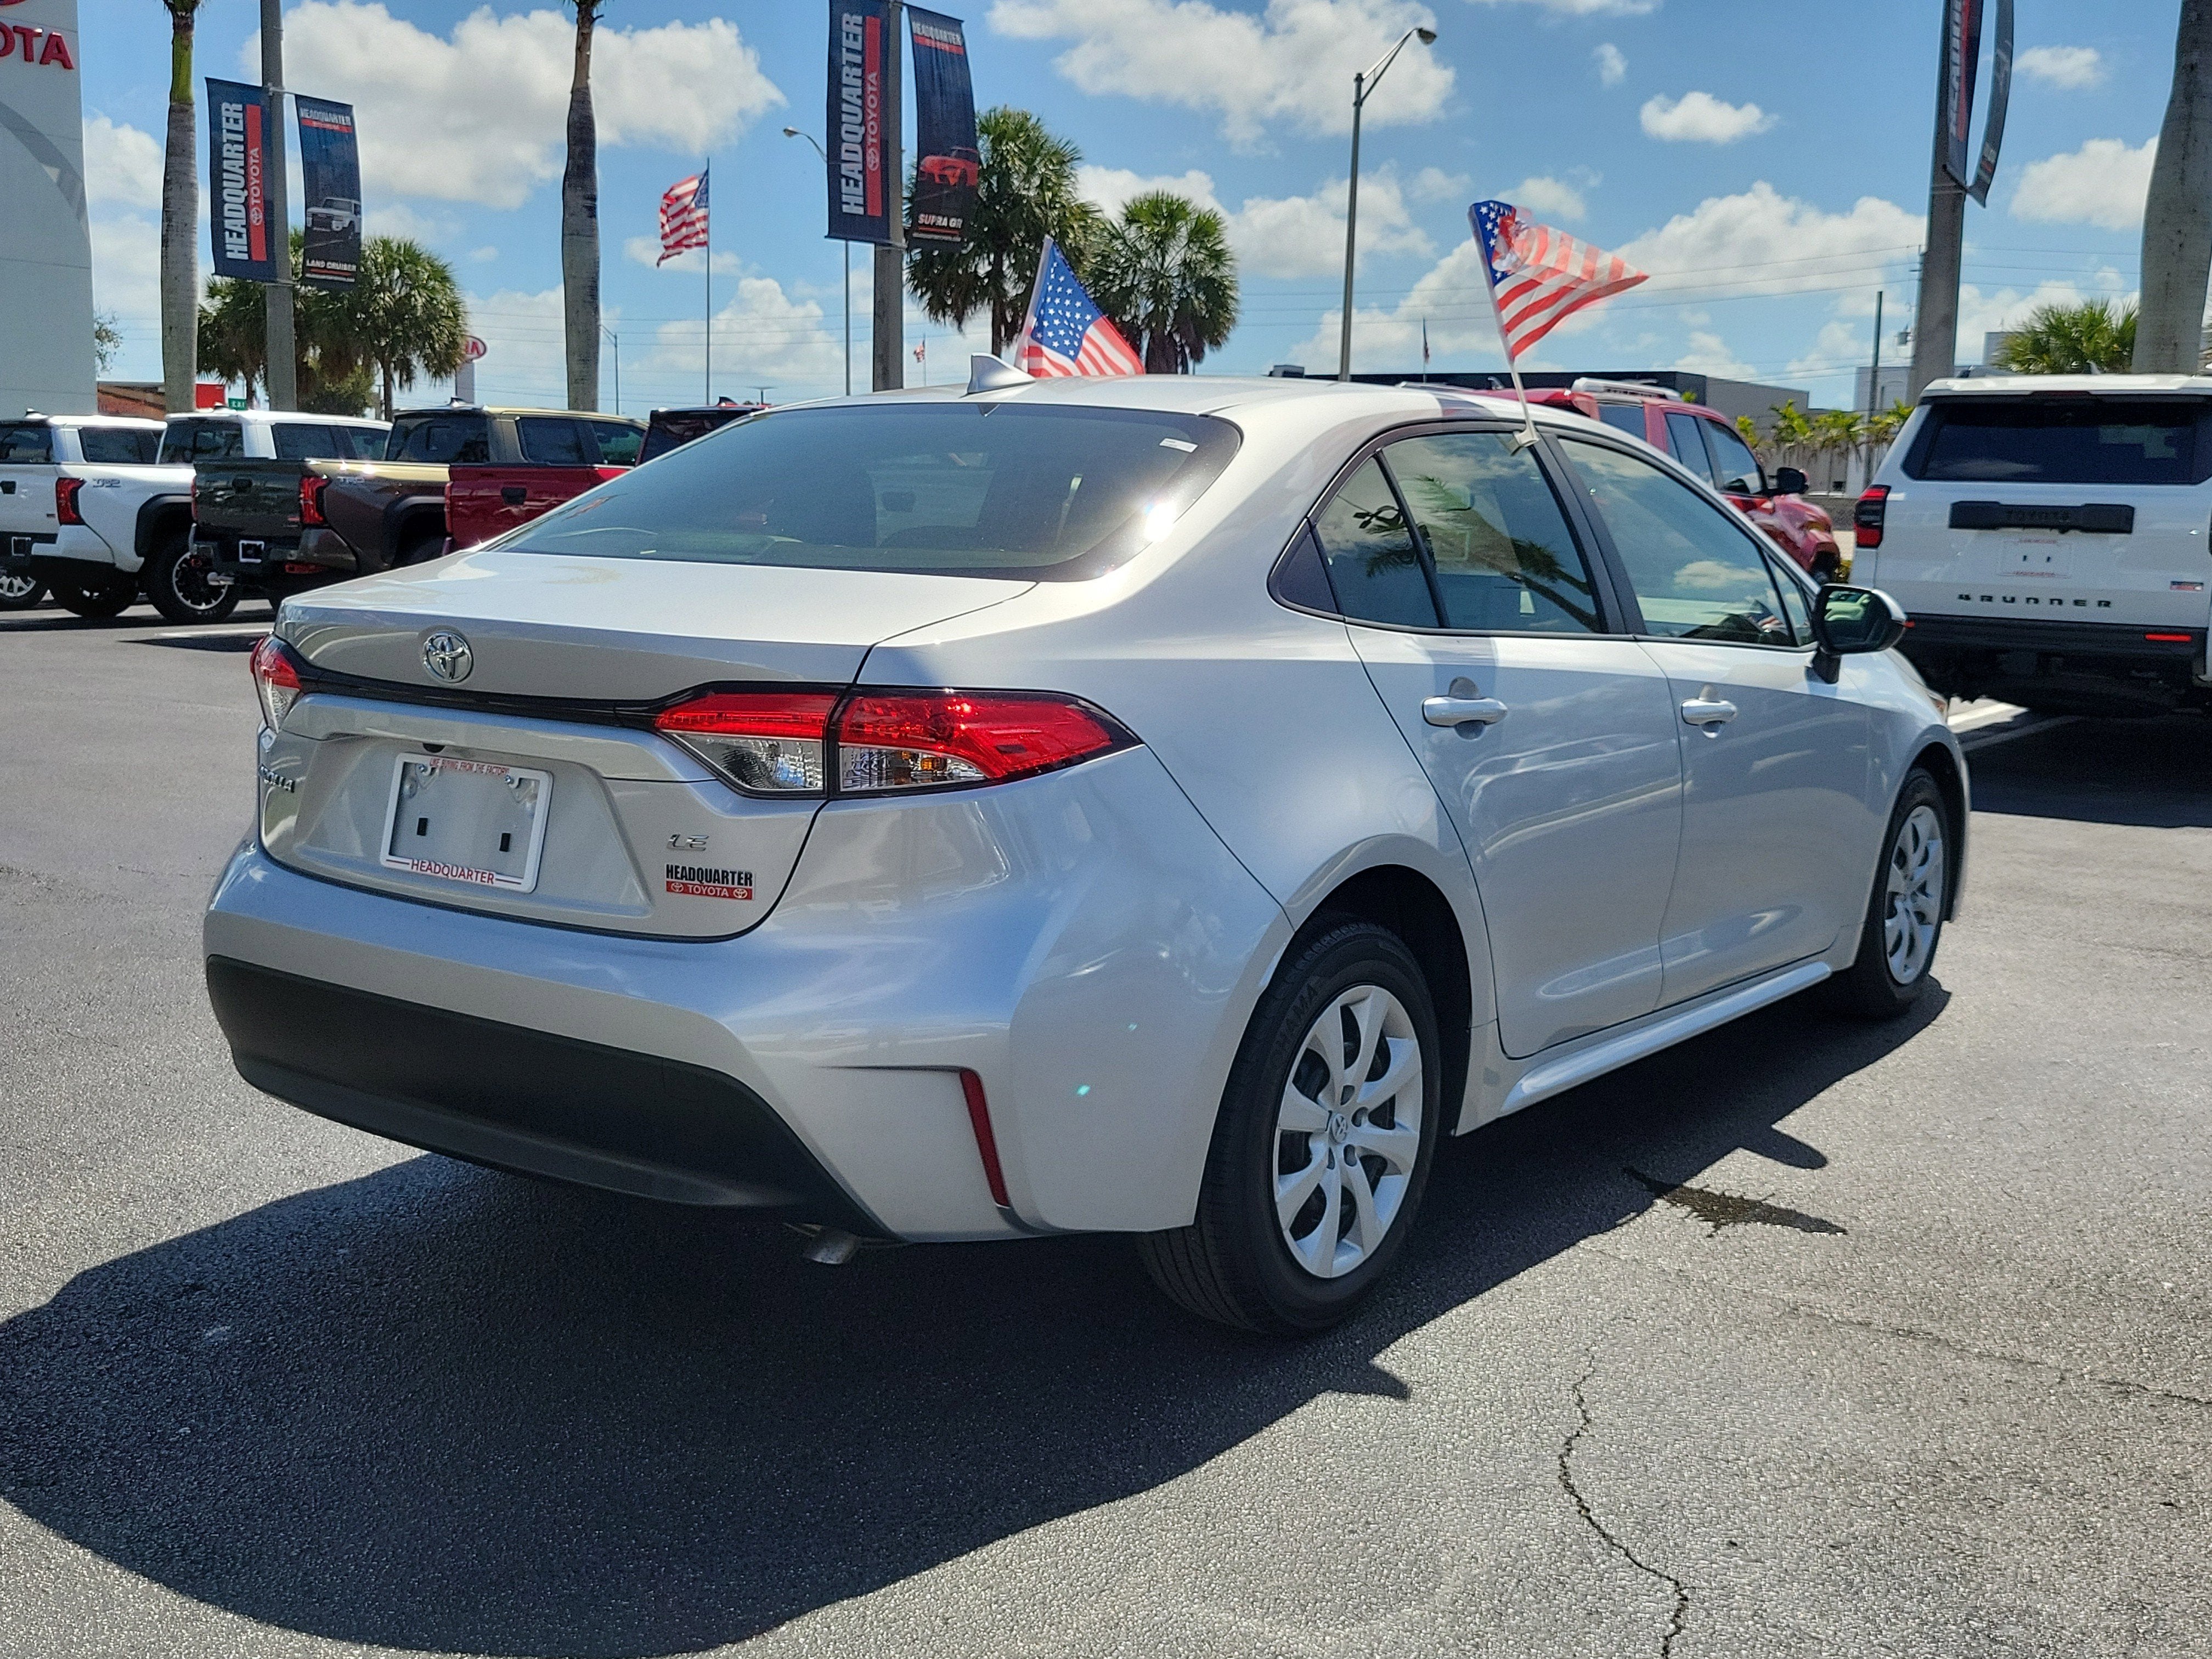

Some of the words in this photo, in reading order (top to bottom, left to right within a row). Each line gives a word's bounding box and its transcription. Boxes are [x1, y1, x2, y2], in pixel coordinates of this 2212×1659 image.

[841, 13, 866, 215] HEADQUARTER
[866, 72, 878, 145] TOYOTA
[221, 102, 249, 260] HEADQUARTER
[249, 148, 262, 206] TOYOTA
[918, 213, 948, 227] SUPRA
[306, 258, 326, 268] LAND
[1957, 594, 2112, 607] 4RUNNER
[667, 833, 709, 851] LE
[411, 859, 494, 884] HEADQUARTER
[666, 864, 753, 887] HEADQUARTER
[687, 884, 729, 897] TOYOTA
